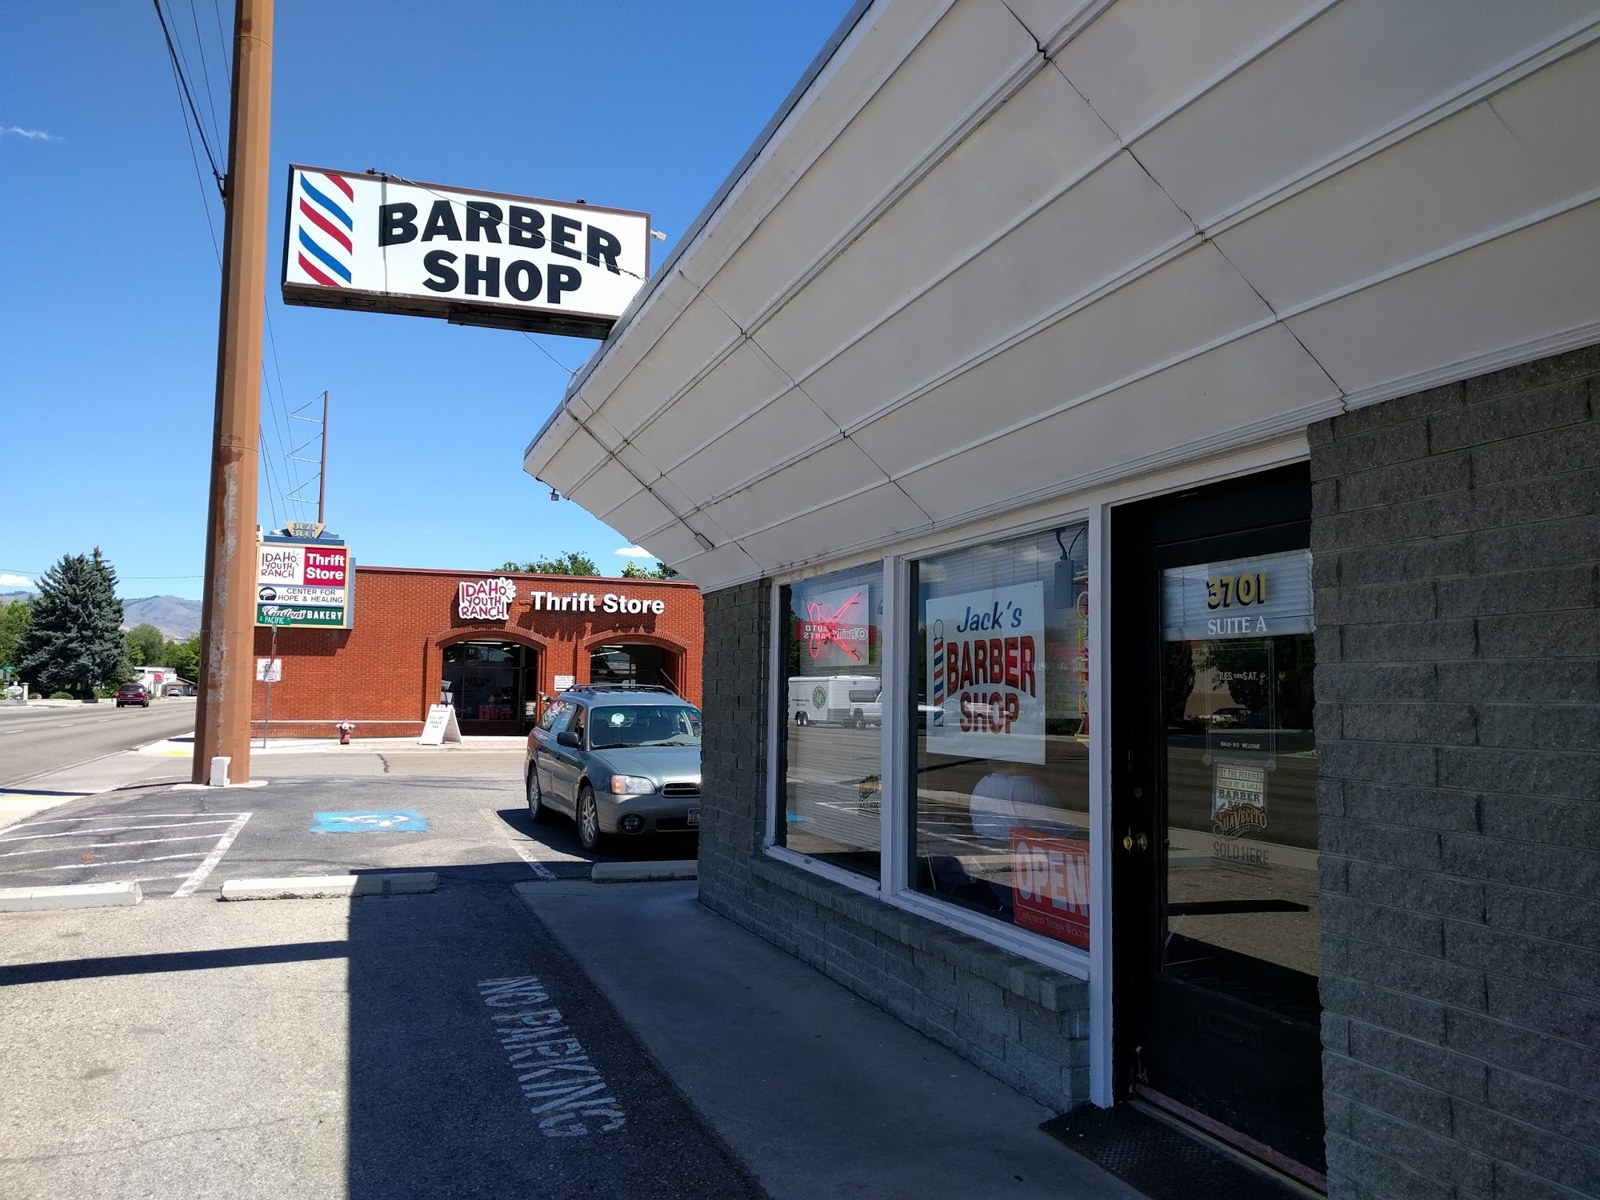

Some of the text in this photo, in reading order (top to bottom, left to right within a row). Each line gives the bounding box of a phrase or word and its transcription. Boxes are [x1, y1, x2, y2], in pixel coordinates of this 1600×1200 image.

[378, 200, 622, 276] BARBER
[422, 249, 582, 304] SHOP
[262, 551, 297, 566] IDAHO
[265, 562, 293, 570] YOUTH
[306, 553, 345, 567] Thrift
[261, 567, 295, 579] RANCH
[306, 566, 344, 580] Store
[278, 594, 299, 602] HOPE
[286, 587, 317, 595] CENTER
[461, 581, 507, 603] IDAHO
[1206, 571, 1266, 610] 3701
[461, 601, 505, 618] RANCH
[465, 595, 502, 608] YOUTH
[530, 591, 665, 614] Thrift Store
[264, 616, 285, 624] PACIFIC
[306, 610, 343, 620] BAKERY
[956, 600, 1023, 633] Jack's
[1207, 615, 1268, 636] SUITE A
[946, 635, 1036, 699] BARBER
[959, 691, 1020, 735] SHOP
[1239, 771, 1263, 780] PERSONAL
[1218, 789, 1261, 803] BARBER
[1213, 805, 1268, 838] SUAVECITO
[1213, 841, 1239, 859] SOLD
[1242, 846, 1269, 866] HERE
[1016, 841, 1088, 917] OPEN
[477, 975, 550, 1007] NO
[490, 1008, 626, 1138] PARKING
